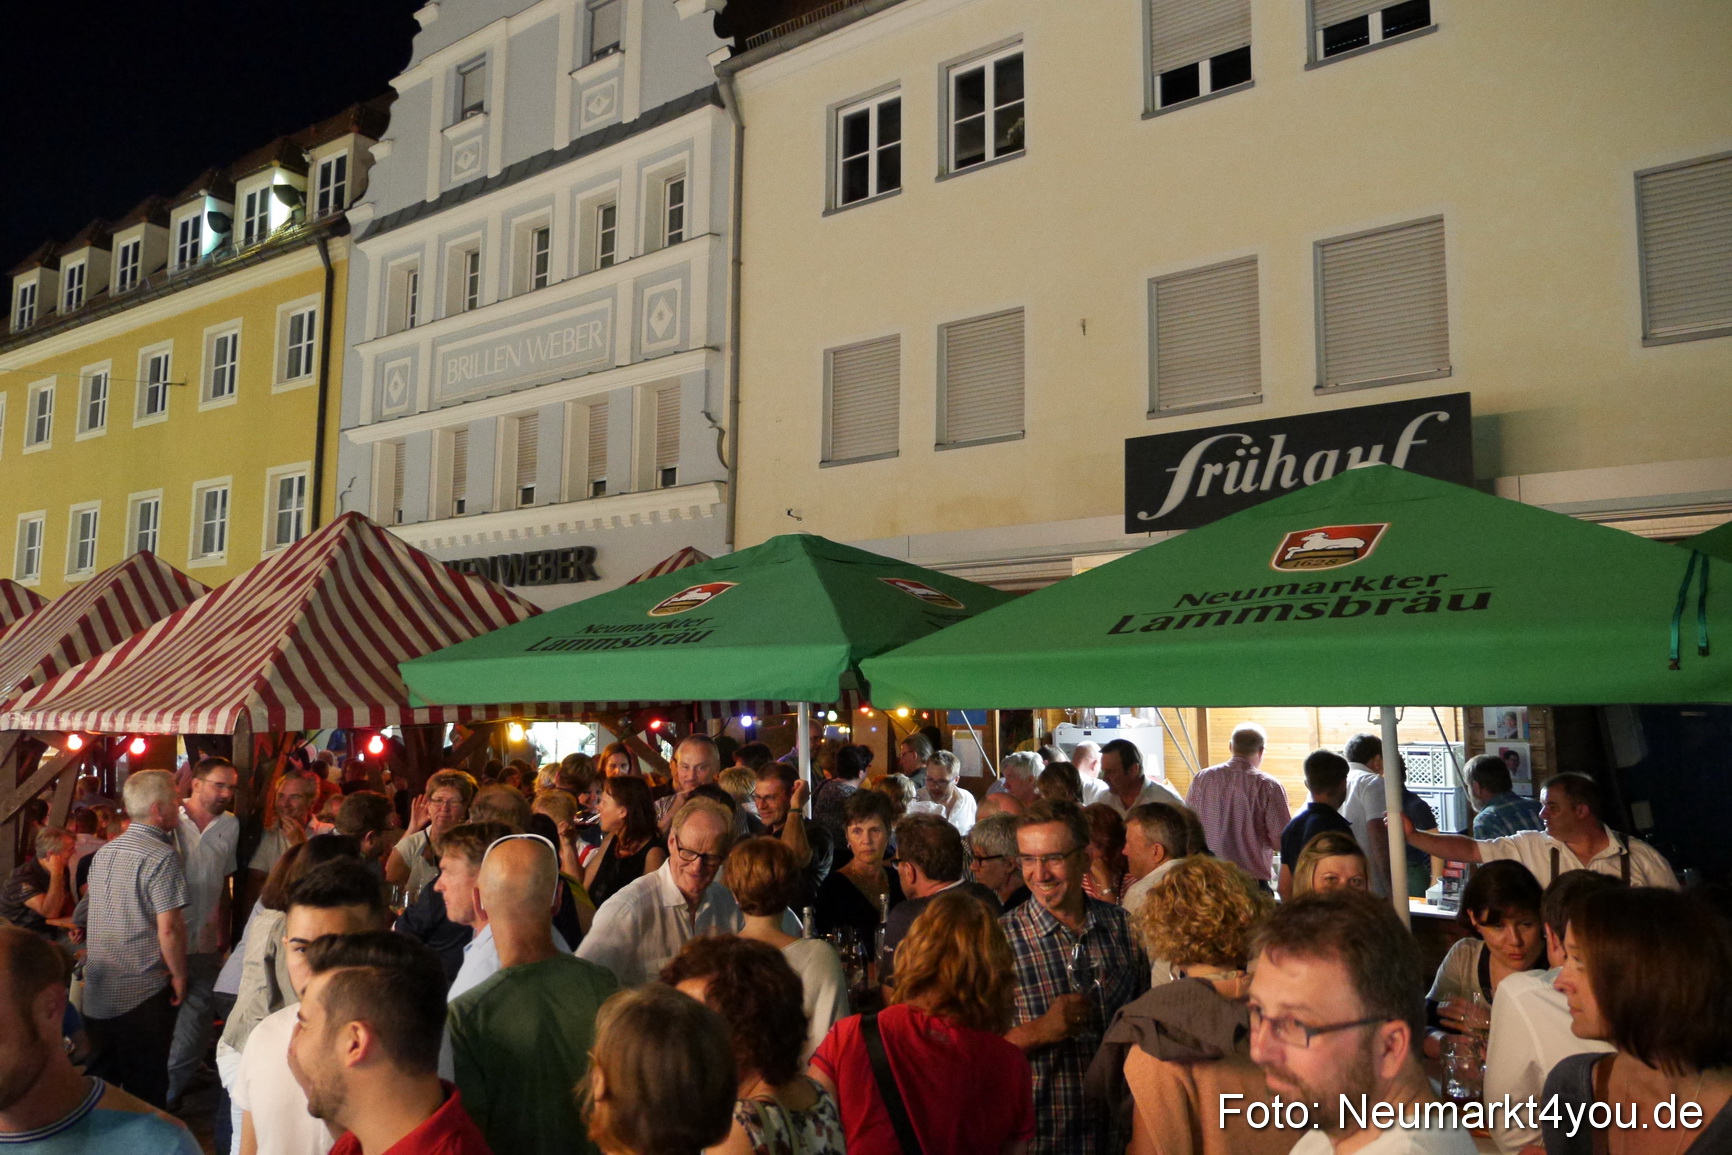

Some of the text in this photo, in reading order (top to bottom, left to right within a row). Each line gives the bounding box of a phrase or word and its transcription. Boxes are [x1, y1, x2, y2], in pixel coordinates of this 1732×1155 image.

[447, 320, 603, 385] BRILLEN WEBER
[498, 546, 601, 587] WEBER
[1293, 559, 1338, 567] 1628
[1173, 573, 1448, 608] Neumarkter
[576, 617, 714, 634] Neumarkter
[1107, 589, 1493, 635] Lammsbräu
[525, 628, 714, 651] Lammsbräu
